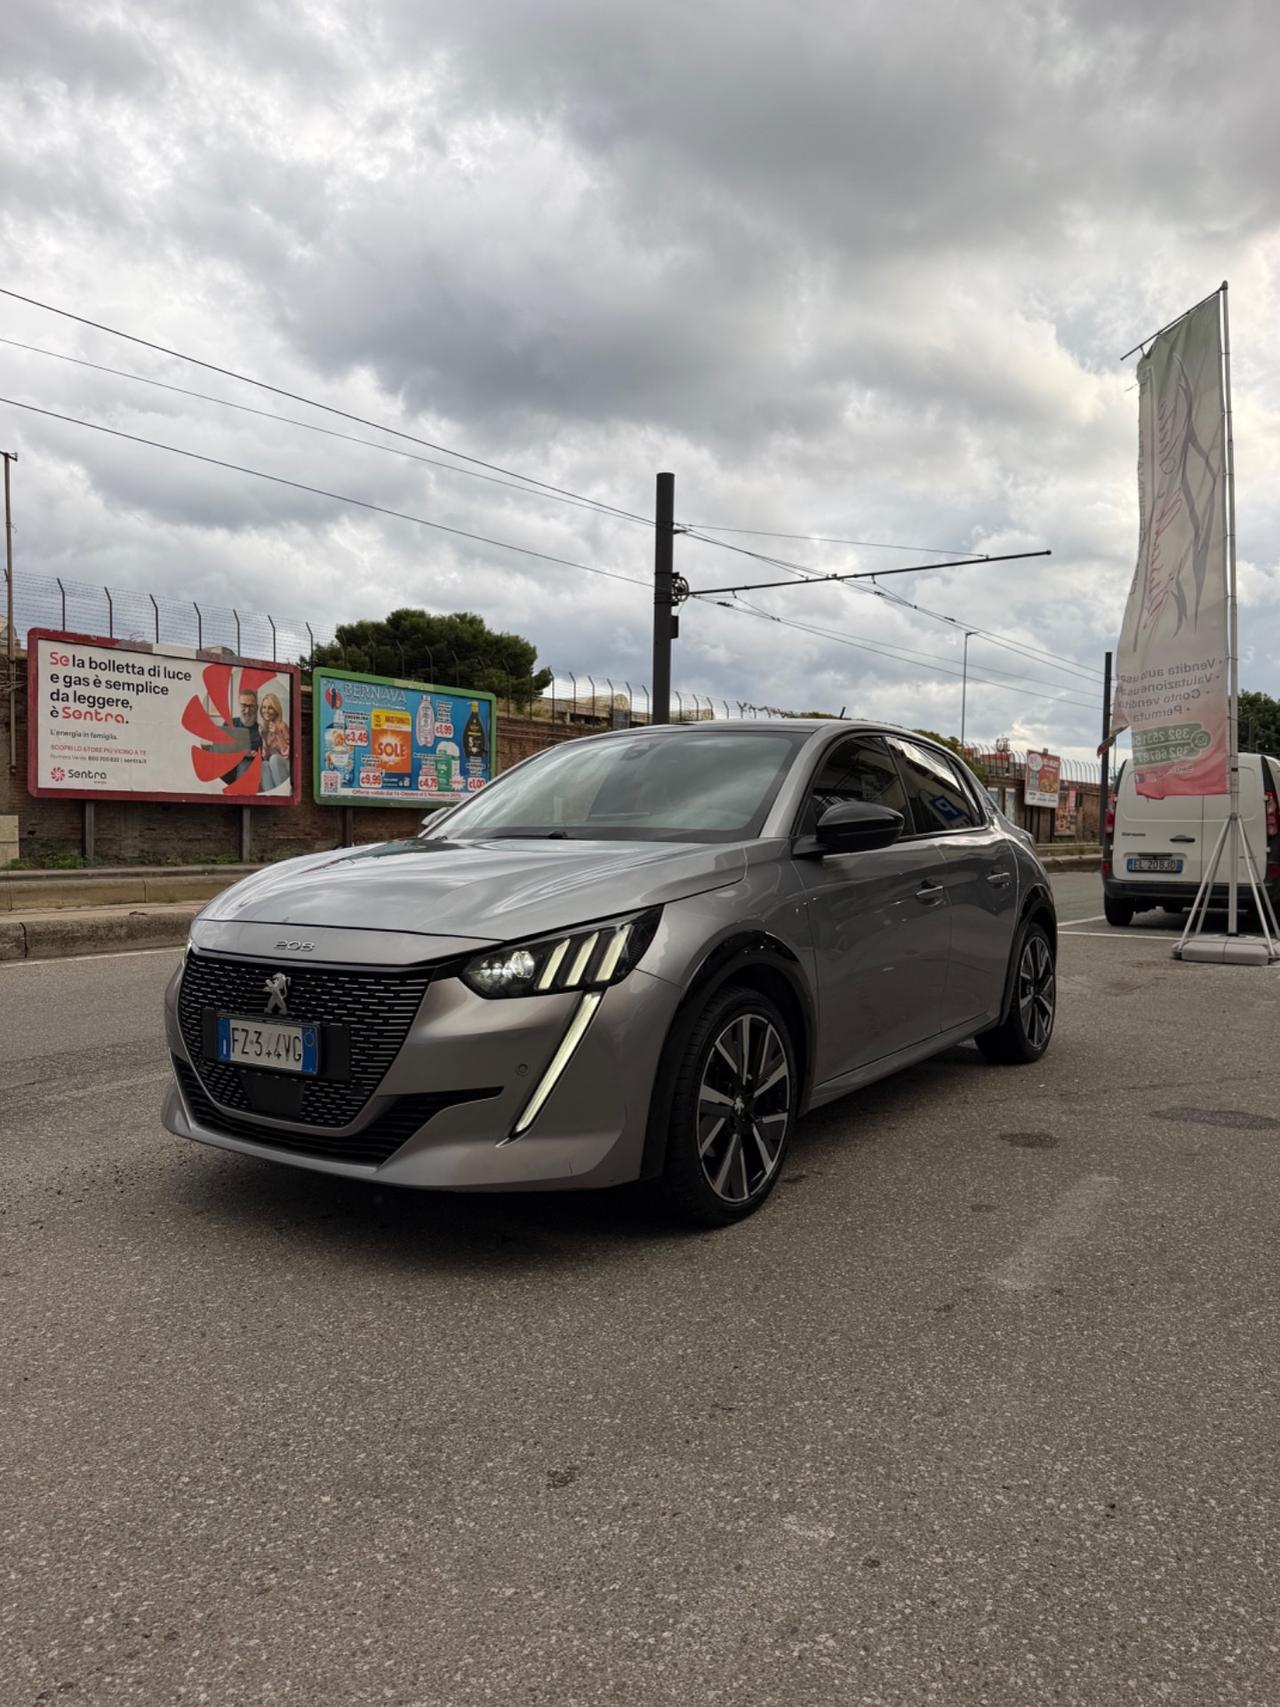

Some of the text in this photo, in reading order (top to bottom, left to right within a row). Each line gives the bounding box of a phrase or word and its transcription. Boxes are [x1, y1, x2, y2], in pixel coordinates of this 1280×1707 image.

[50, 652, 192, 681] Se la bolletta di luce
[50, 673, 169, 696] e gas è semplice
[50, 689, 133, 711] da leggere,
[50, 706, 129, 724] è Sentra.
[378, 742, 408, 757] SOLE
[68, 768, 107, 780] Sentra
[273, 939, 316, 952] 208
